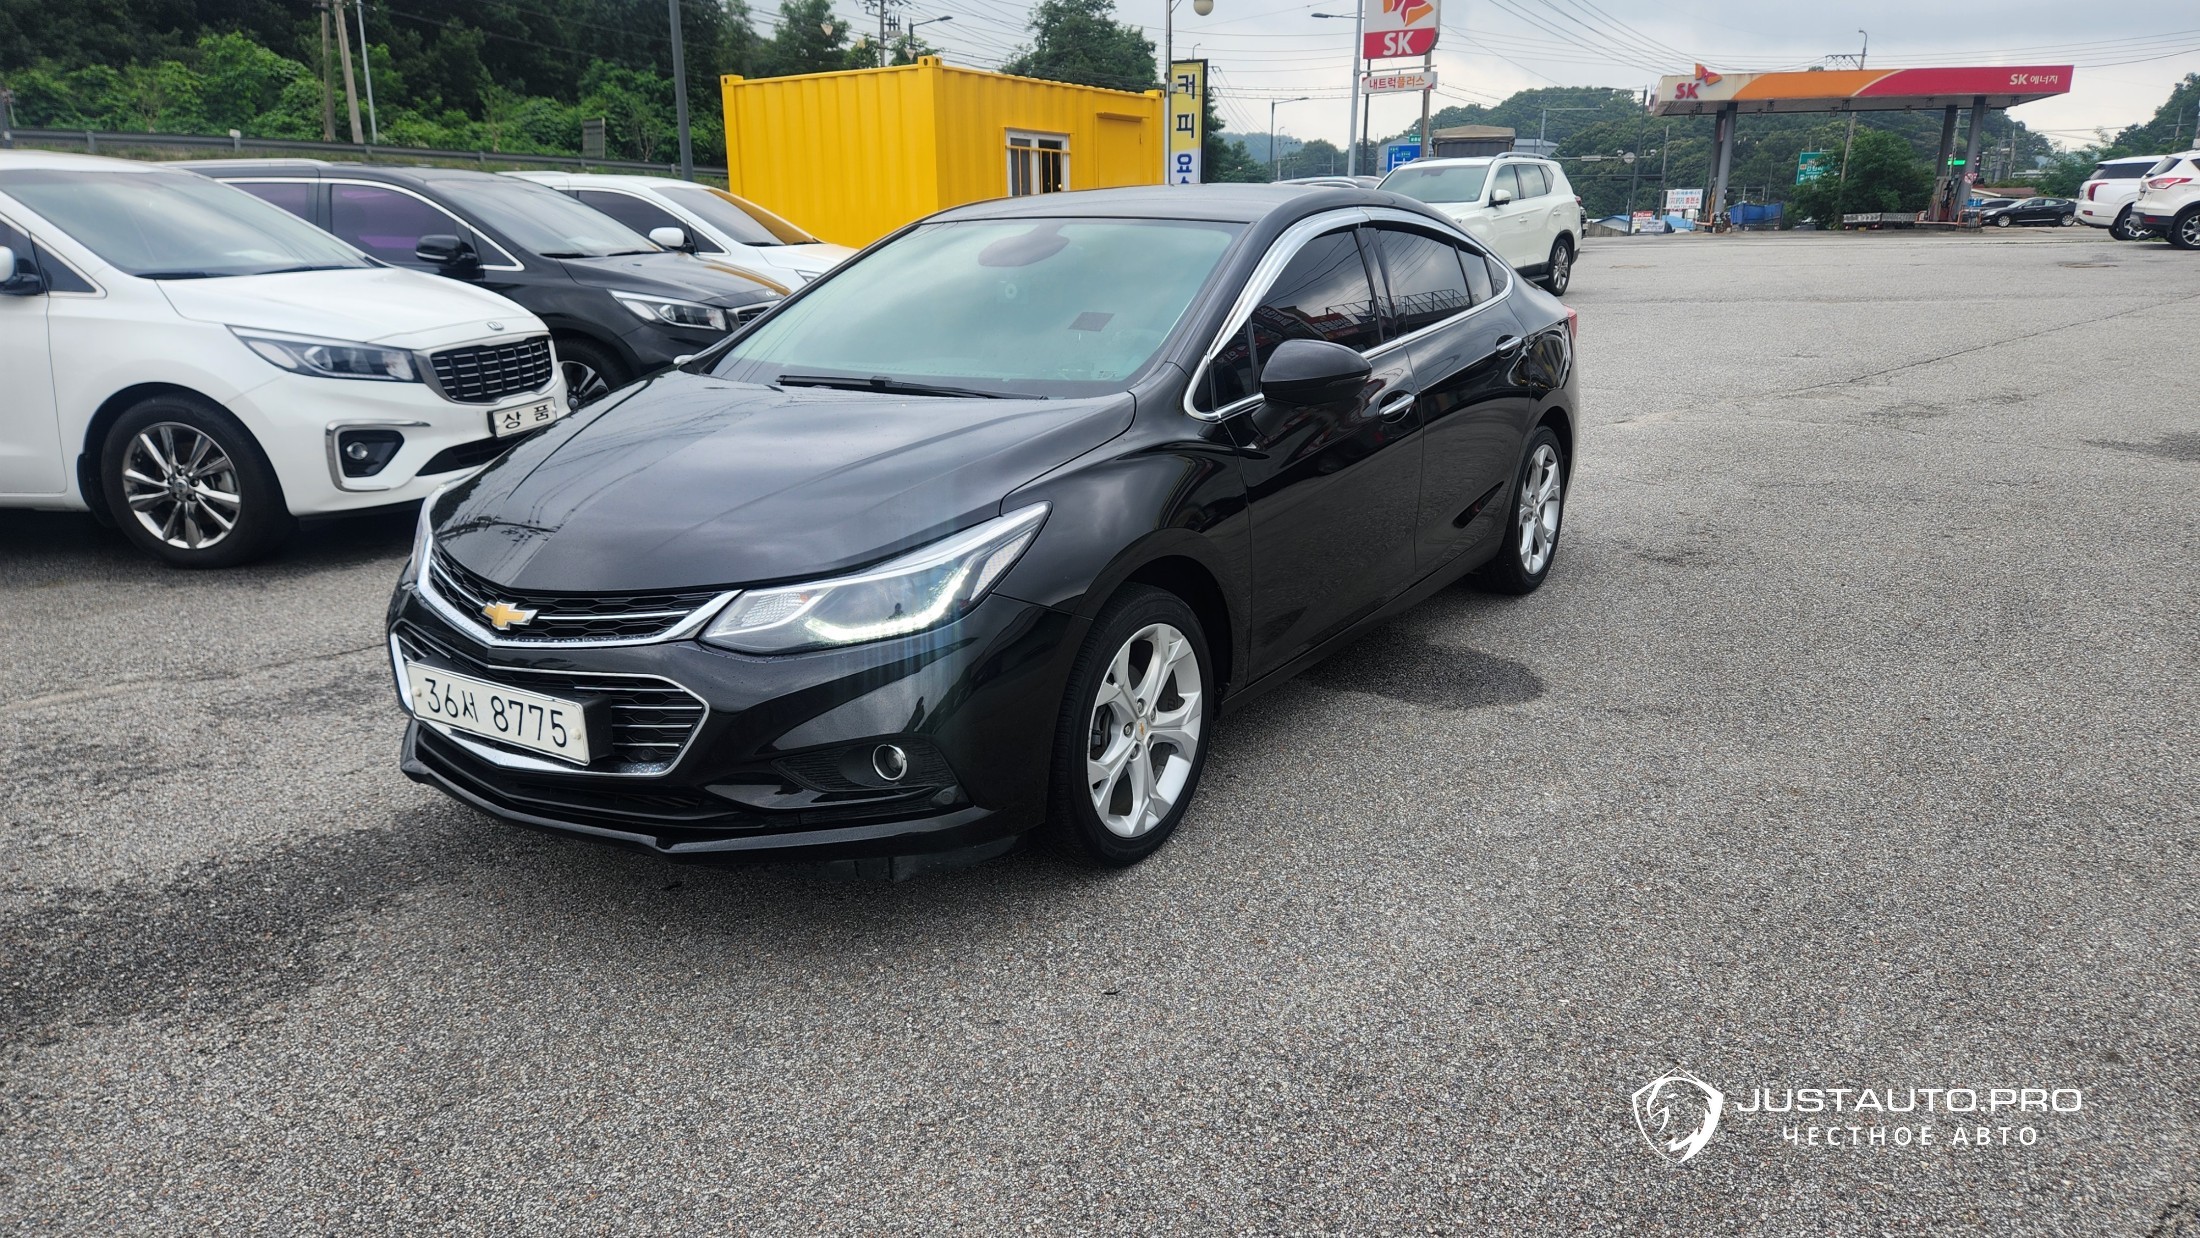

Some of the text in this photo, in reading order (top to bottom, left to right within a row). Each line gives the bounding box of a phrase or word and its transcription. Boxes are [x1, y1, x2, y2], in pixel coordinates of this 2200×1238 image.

[1382, 31, 1414, 56] SK
[1369, 75, 1425, 90] 내트럭플러스
[1674, 82, 1701, 99] SK
[2009, 73, 2058, 85] SK 에너지
[1176, 73, 1196, 139] 커피
[503, 404, 549, 429] 상품
[424, 677, 567, 748] 36서 8775
